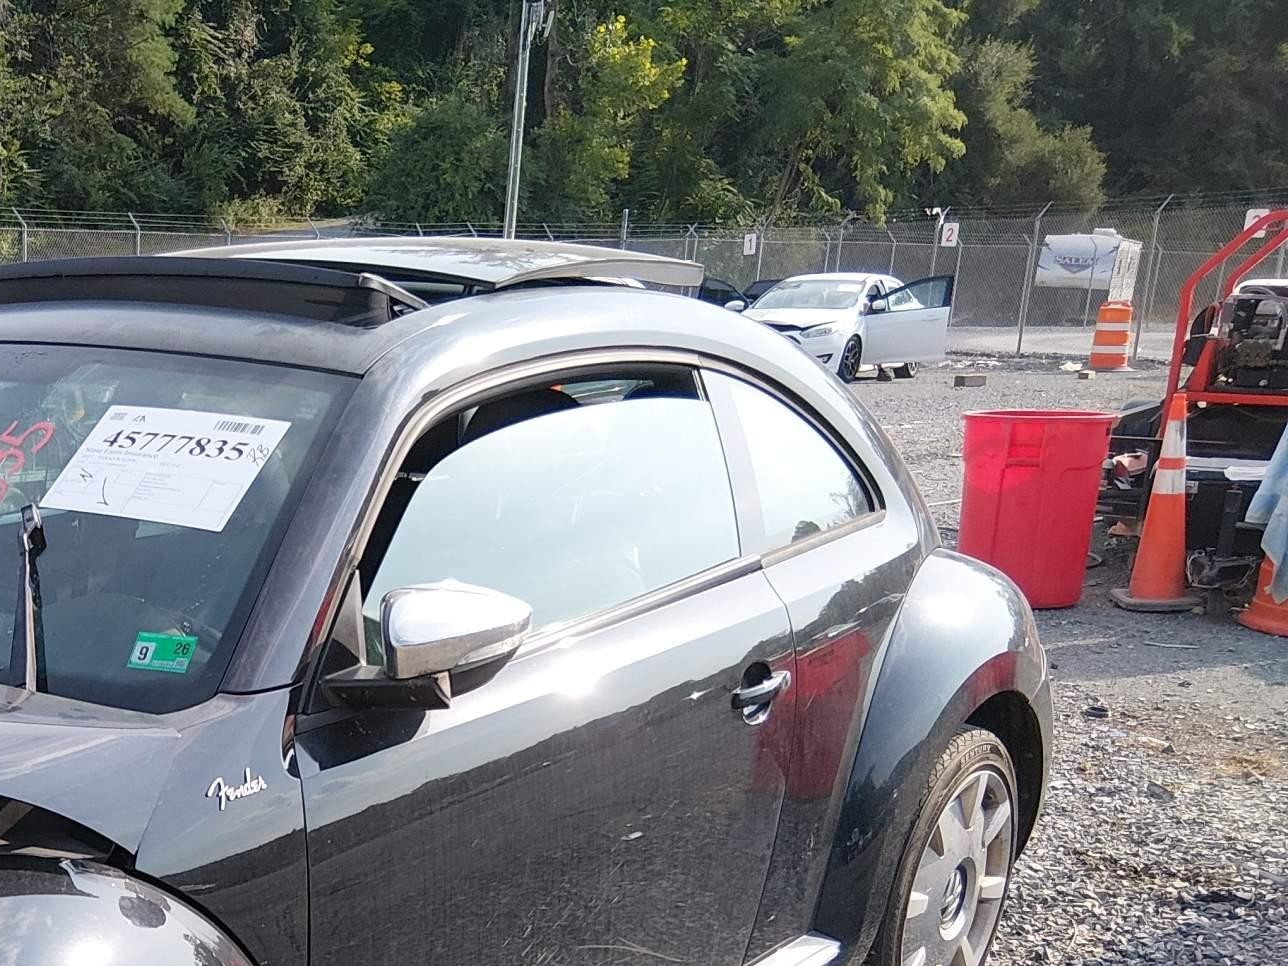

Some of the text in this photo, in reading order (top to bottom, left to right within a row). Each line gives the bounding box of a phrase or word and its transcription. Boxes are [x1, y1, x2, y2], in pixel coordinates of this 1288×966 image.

[945, 227, 955, 243] 2
[103, 429, 250, 461] 45777835
[137, 642, 192, 661] 9 26
[204, 767, 268, 811] Fender
